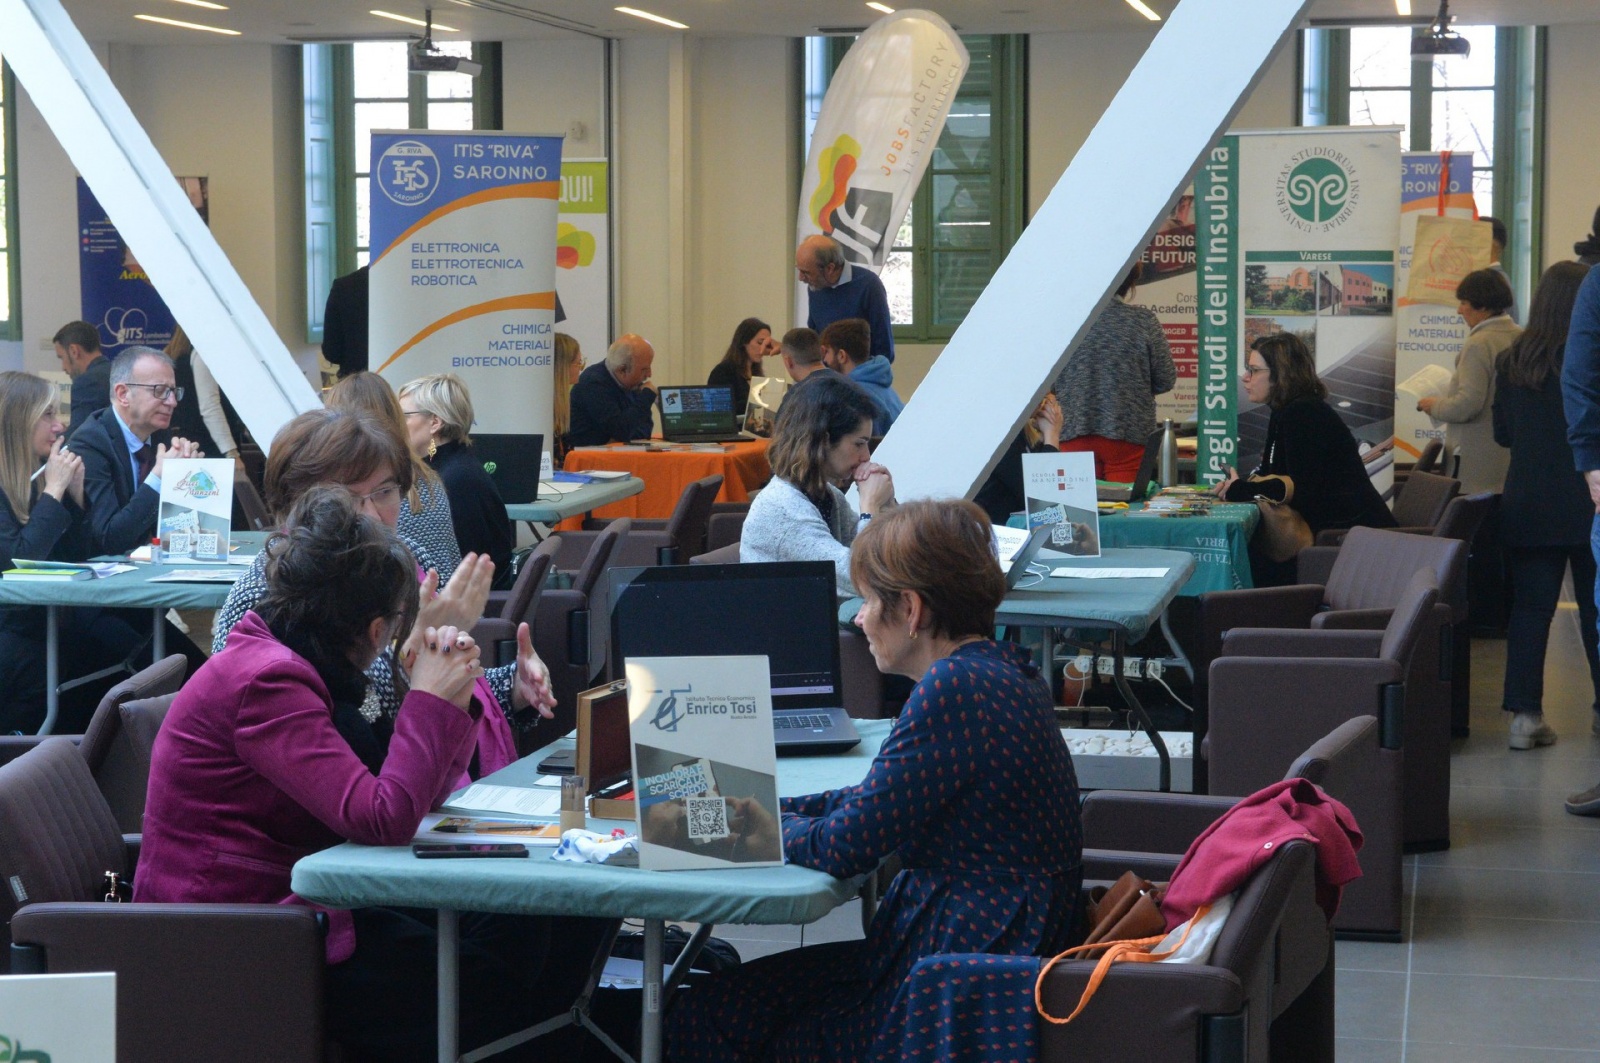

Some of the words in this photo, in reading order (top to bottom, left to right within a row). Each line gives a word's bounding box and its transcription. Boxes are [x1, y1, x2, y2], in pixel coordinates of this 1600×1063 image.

[454, 143, 484, 158] ITIS
[1291, 146, 1356, 176] STUDIORUM
[453, 165, 547, 180] SARONNO
[1410, 163, 1454, 175] "RIV"
[393, 191, 424, 201] SARONNO
[411, 243, 500, 254] ELETTRONICA
[411, 259, 524, 270] ELETTROTECNICA
[411, 275, 477, 286] ROBOTICA
[1420, 315, 1464, 325] CHIMICA
[126, 327, 143, 339] ITS
[502, 323, 551, 335] CHIMICA
[1409, 328, 1465, 339] MATERIALI
[452, 355, 551, 367] BIOTECNOLOGIE
[1204, 336, 1228, 410] Studi
[686, 701, 728, 715] Enrico
[730, 701, 756, 714] Tosi
[644, 765, 696, 787] INQUADRA
[649, 777, 694, 796] SCARICA
[668, 782, 709, 800] SCHEDA
